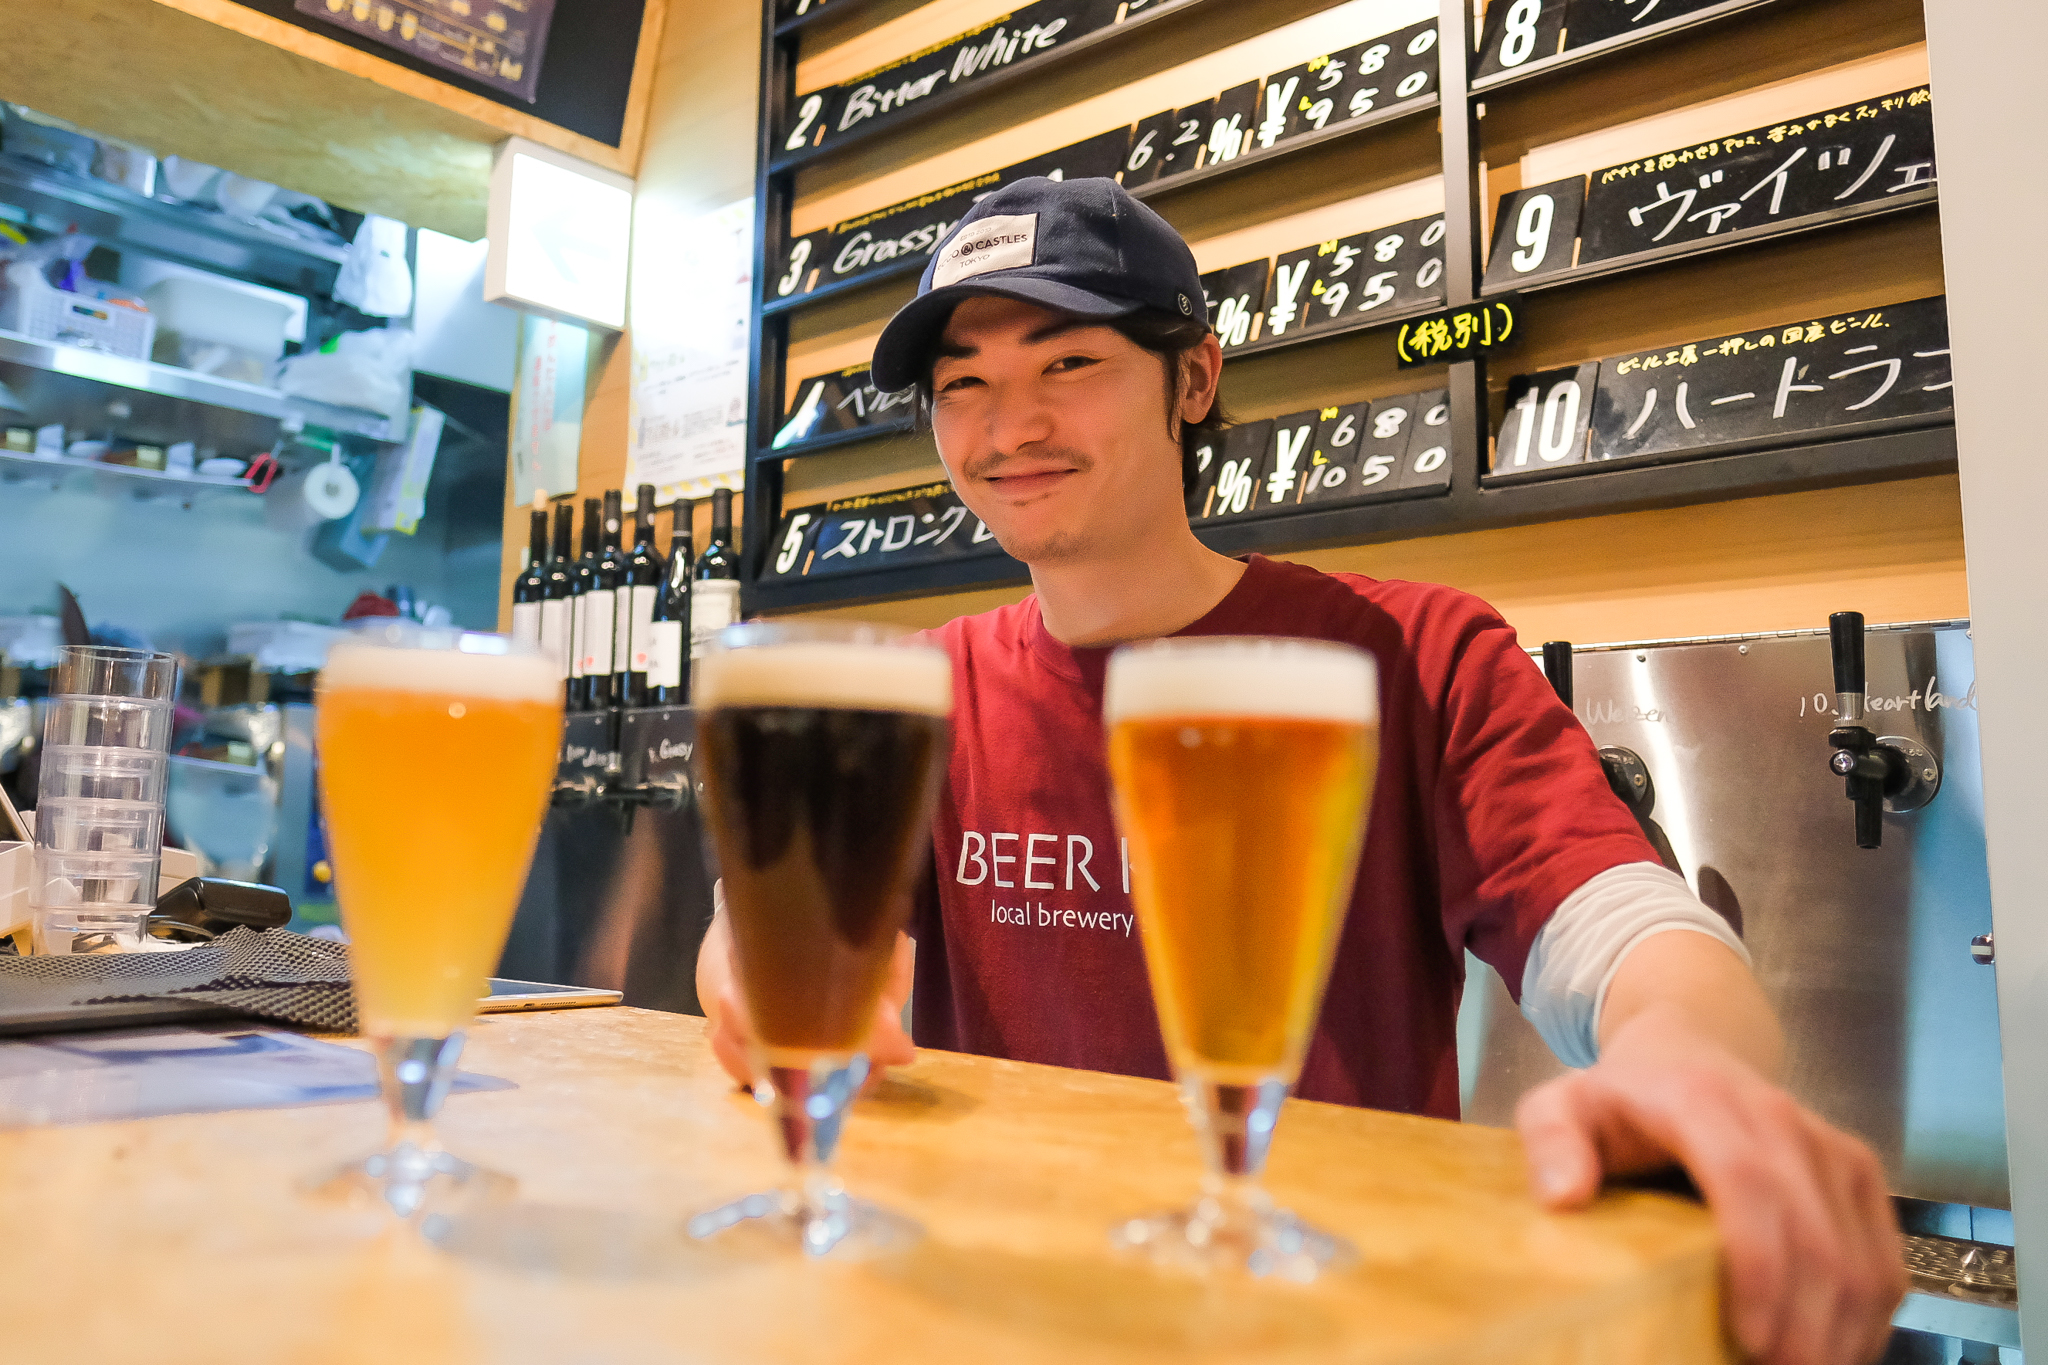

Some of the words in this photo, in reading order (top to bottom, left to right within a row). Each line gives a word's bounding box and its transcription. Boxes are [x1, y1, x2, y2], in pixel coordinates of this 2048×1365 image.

[1316, 28, 1438, 92] 580
[1499, 0, 1542, 67] 8
[838, 69, 947, 132] Bitter
[949, 18, 1068, 83] White
[1305, 70, 1429, 130] 950
[1257, 75, 1301, 149] ¥
[832, 219, 960, 275] Grassy
[960, 254, 991, 268] TOKYO
[976, 234, 1028, 250] CASTLES
[1511, 193, 1555, 273] 9
[1267, 259, 1311, 336] ¥
[1320, 257, 1444, 318] 950
[1397, 303, 1514, 362] (税別)
[1320, 406, 1339, 422] M
[1514, 380, 1582, 467] 10
[1266, 425, 1311, 504] ¥
[1305, 446, 1447, 495] 1050
[775, 512, 812, 575] 5
[956, 831, 1101, 892] BEER
[991, 899, 1031, 926] local
[1038, 902, 1134, 938] brewery
